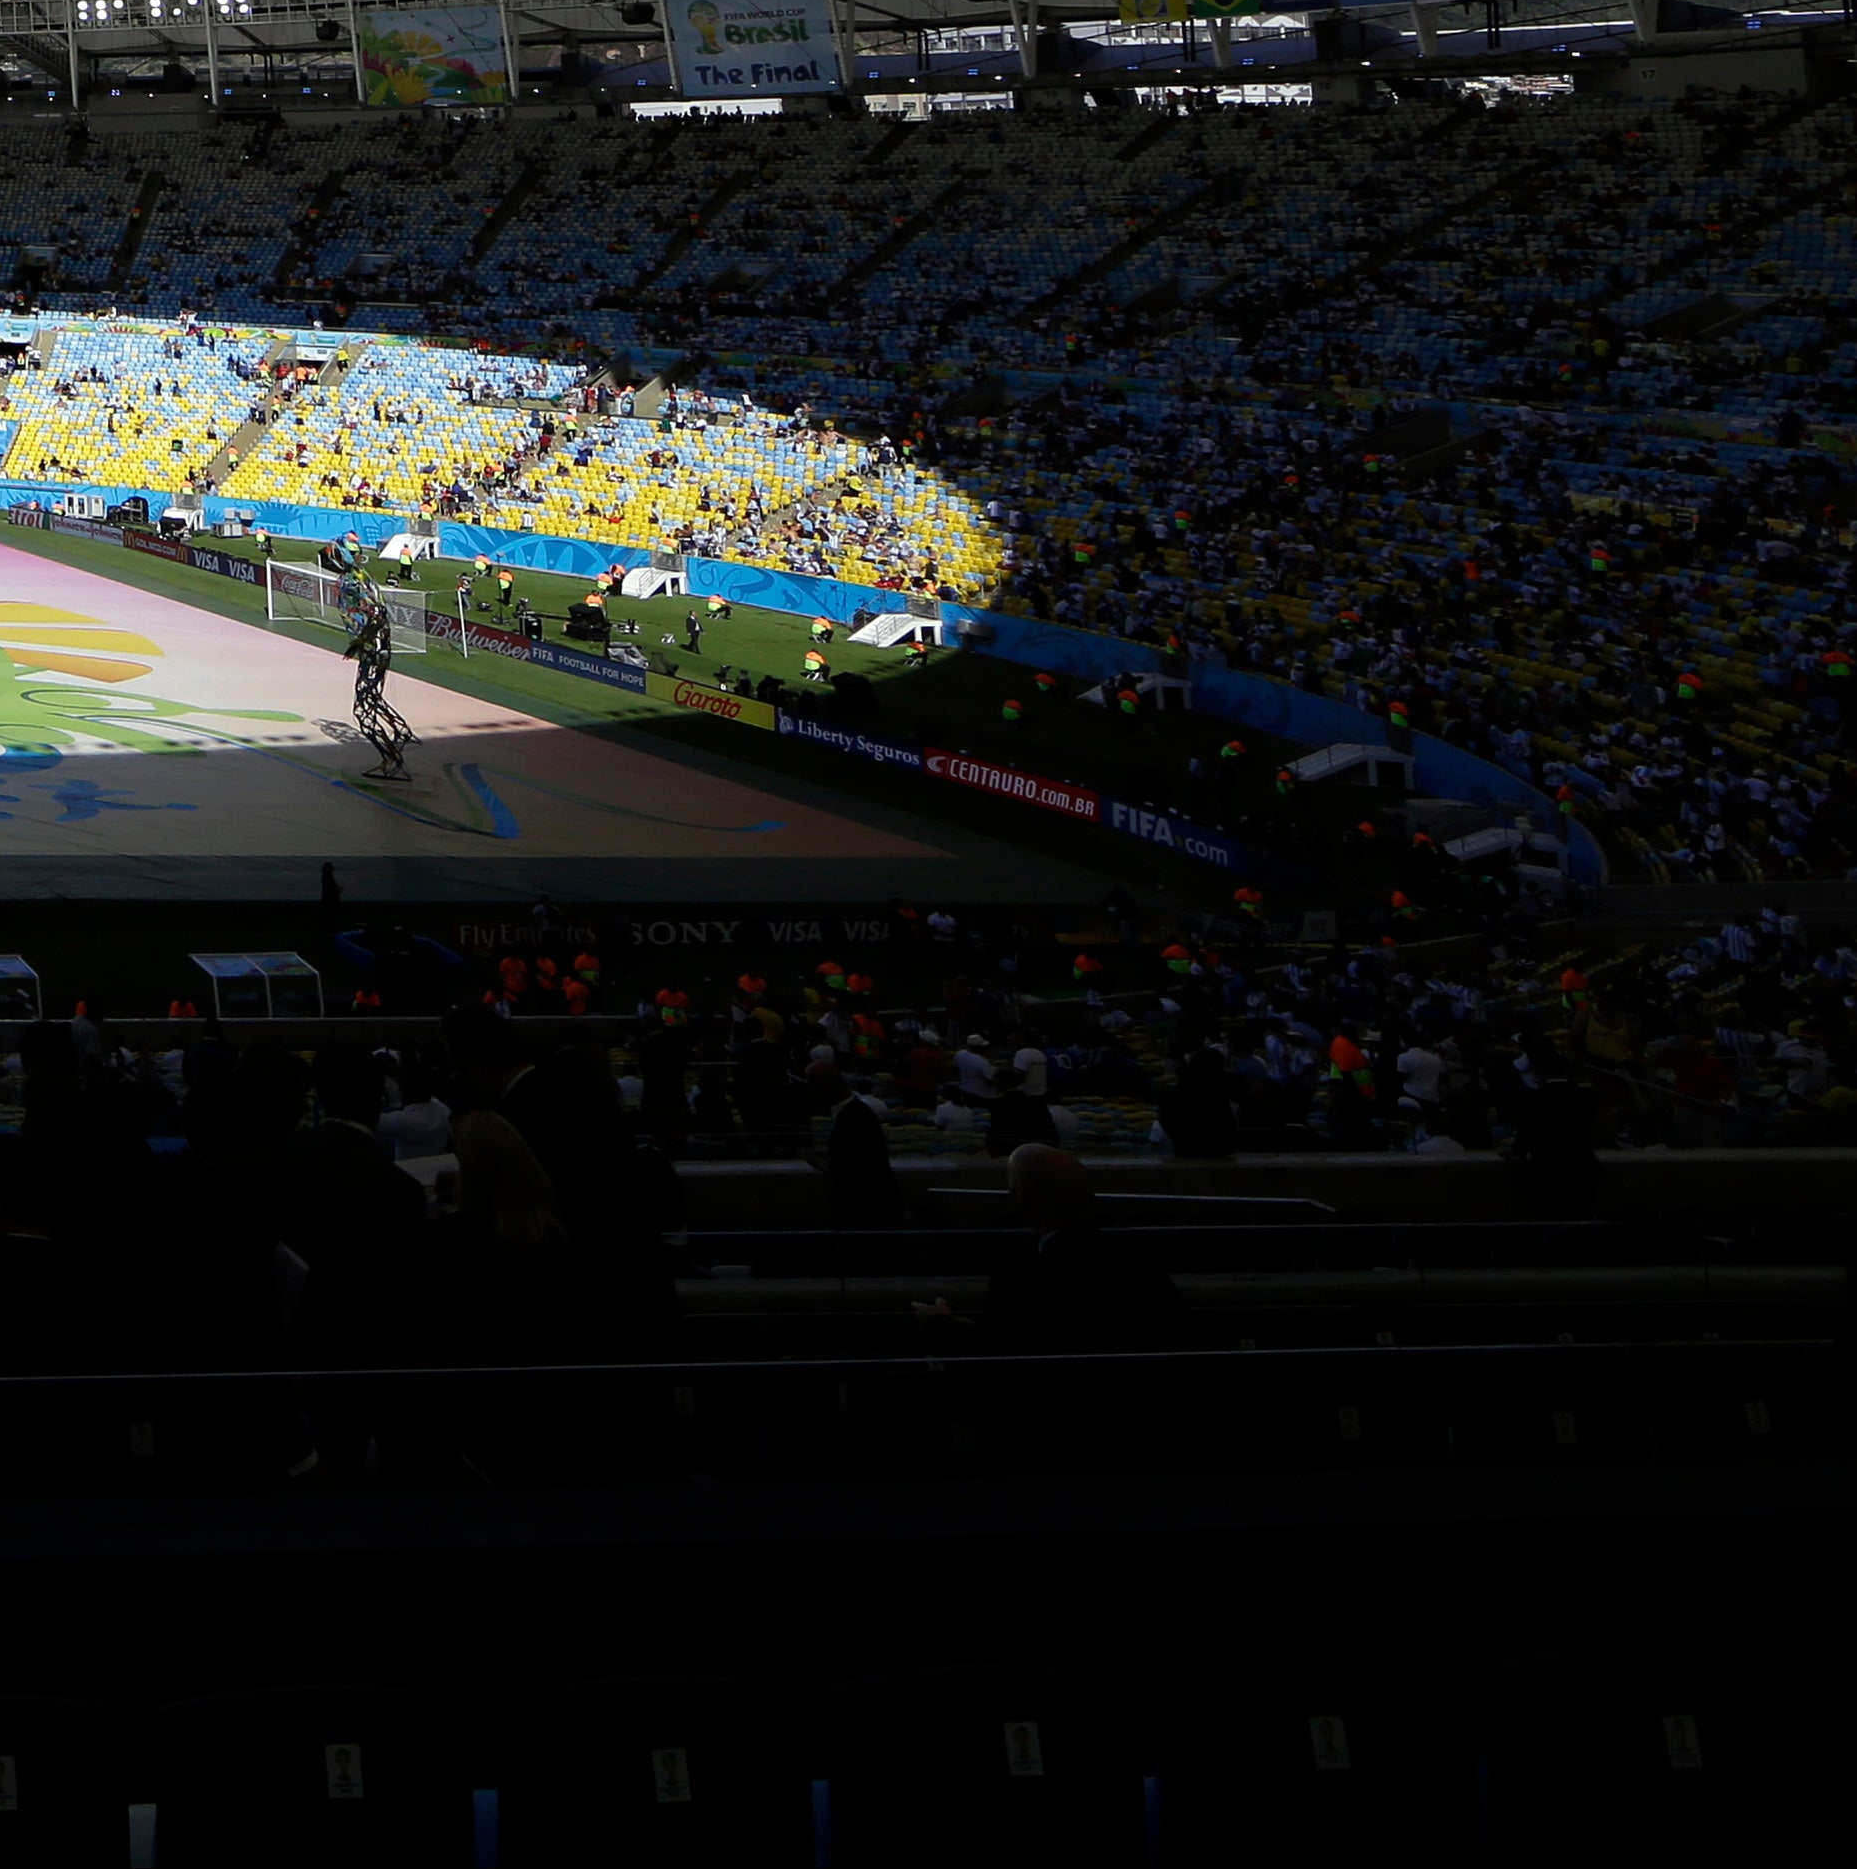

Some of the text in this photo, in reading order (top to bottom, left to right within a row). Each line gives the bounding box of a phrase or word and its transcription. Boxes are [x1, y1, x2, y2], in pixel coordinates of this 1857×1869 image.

[724, 8, 807, 21] FIFA WORLD CUP
[724, 18, 810, 45] Brasil
[695, 59, 820, 86] The Final
[192, 549, 220, 573] VISA
[228, 559, 256, 583] VISA
[426, 612, 531, 662] Budweiser
[532, 646, 645, 689] FIFA FOOTBALL FOR HOPE
[673, 680, 743, 719] Garoto
[798, 719, 921, 767] Liberty Seguros
[458, 923, 494, 949] Fly
[630, 920, 742, 947] SONY
[766, 920, 823, 944] VISA
